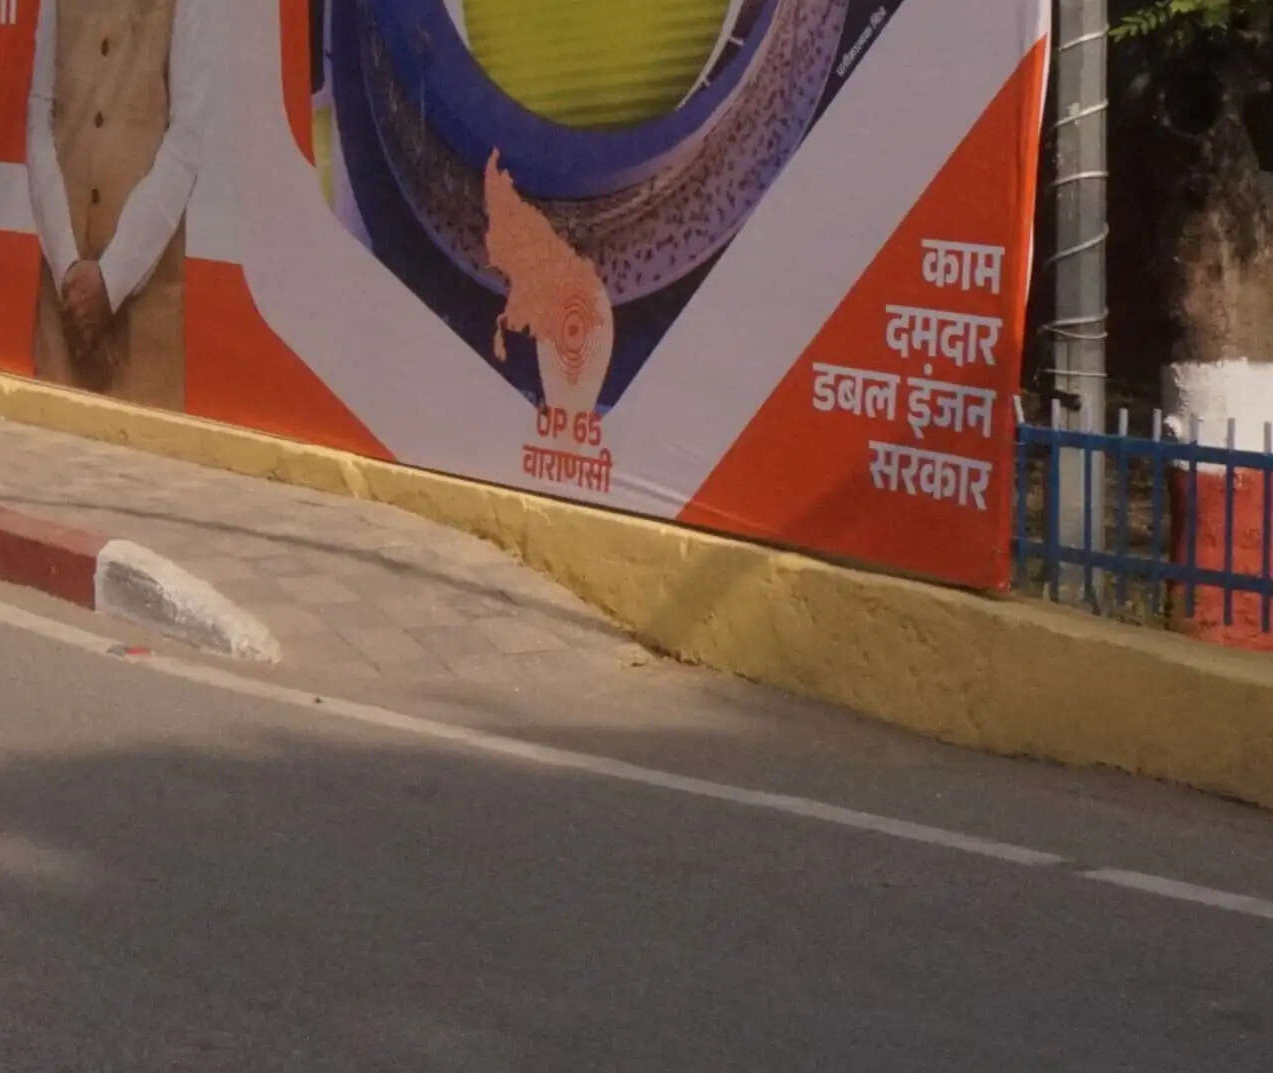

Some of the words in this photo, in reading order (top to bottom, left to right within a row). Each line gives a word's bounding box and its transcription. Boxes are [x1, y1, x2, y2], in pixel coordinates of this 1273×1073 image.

[922, 239, 1004, 294] काम
[886, 304, 1002, 366] दमदार
[537, 406, 566, 440] UP
[574, 411, 602, 446] 65
[813, 362, 900, 421] डबल
[908, 363, 996, 439] इंजन
[523, 444, 612, 493] वाराणसी
[869, 440, 992, 511] सरकार
